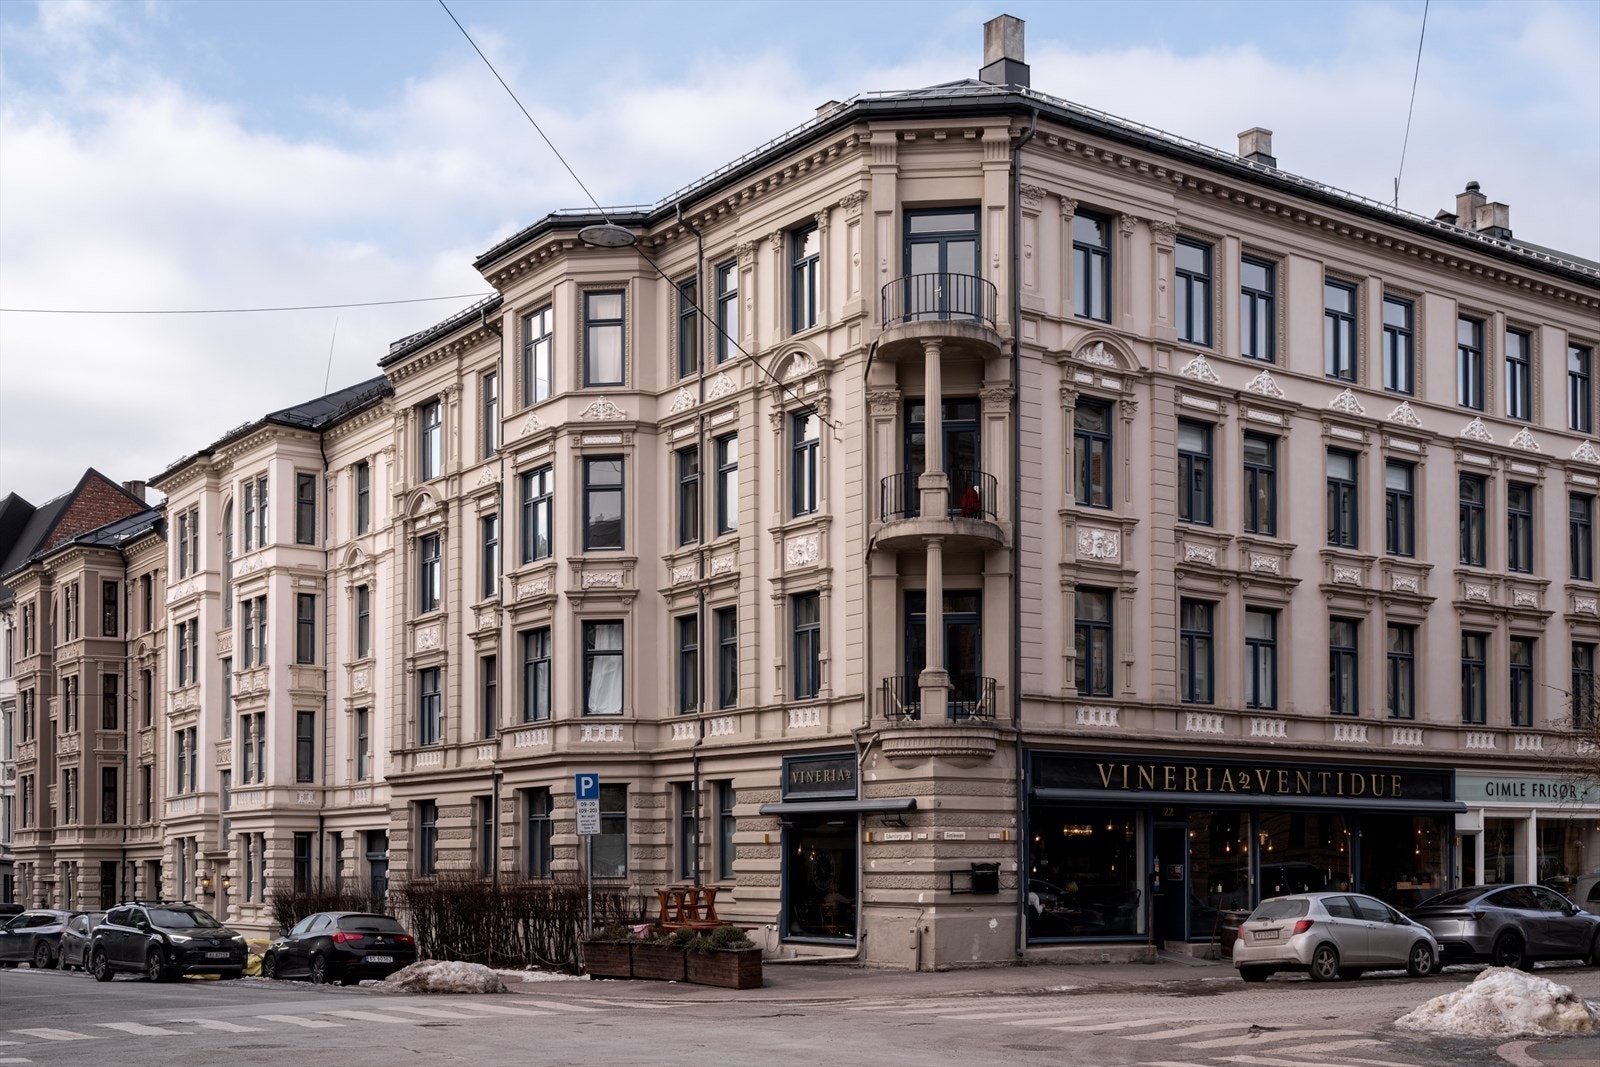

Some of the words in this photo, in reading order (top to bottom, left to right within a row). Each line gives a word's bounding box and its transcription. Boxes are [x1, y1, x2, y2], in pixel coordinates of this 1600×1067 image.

[792, 768, 845, 784] VINERIA
[1096, 763, 1236, 792] VINERIA
[1255, 769, 1402, 797] VENTIDUE
[581, 776, 594, 797] P
[1485, 782, 1526, 797] GIMLE
[1532, 783, 1577, 799] FRISØR
[1163, 807, 1175, 817] 22
